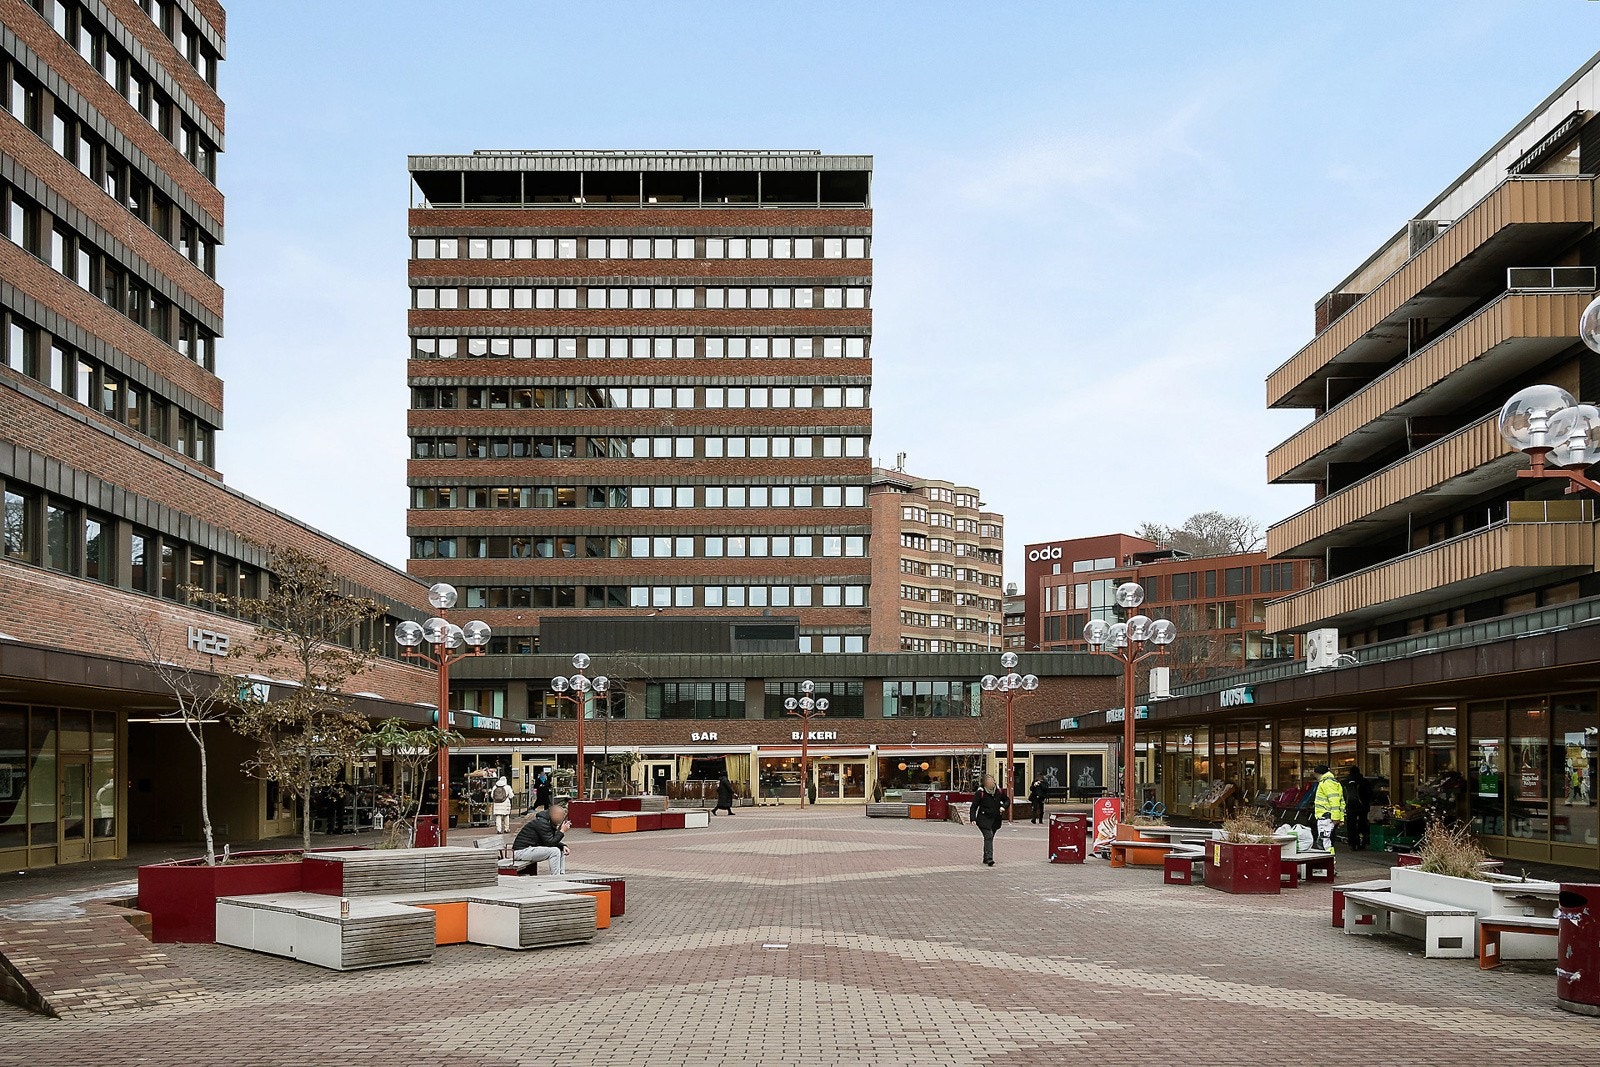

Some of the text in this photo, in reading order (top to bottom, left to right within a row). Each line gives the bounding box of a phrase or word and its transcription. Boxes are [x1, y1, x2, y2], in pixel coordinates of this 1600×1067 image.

[1029, 545, 1062, 561] oda
[187, 626, 230, 656] H22
[1220, 686, 1247, 707] KIOSK
[691, 732, 718, 741] BAR
